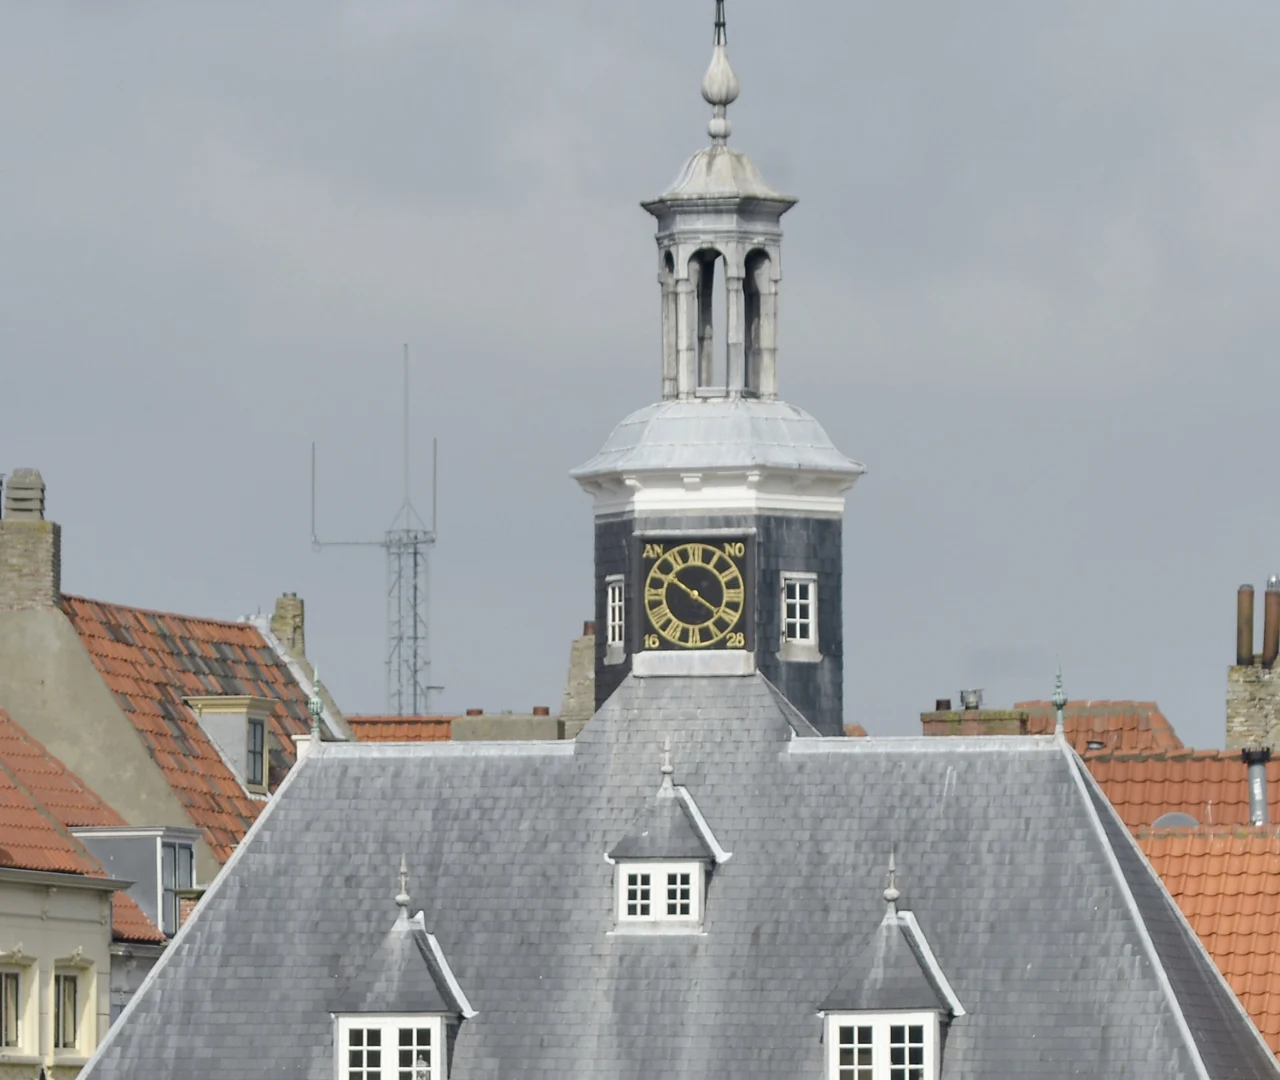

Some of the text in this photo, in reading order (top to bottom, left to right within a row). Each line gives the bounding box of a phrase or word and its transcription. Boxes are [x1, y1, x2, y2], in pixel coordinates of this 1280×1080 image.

[642, 542, 745, 558] AN NO
[643, 632, 745, 648] 16 28
